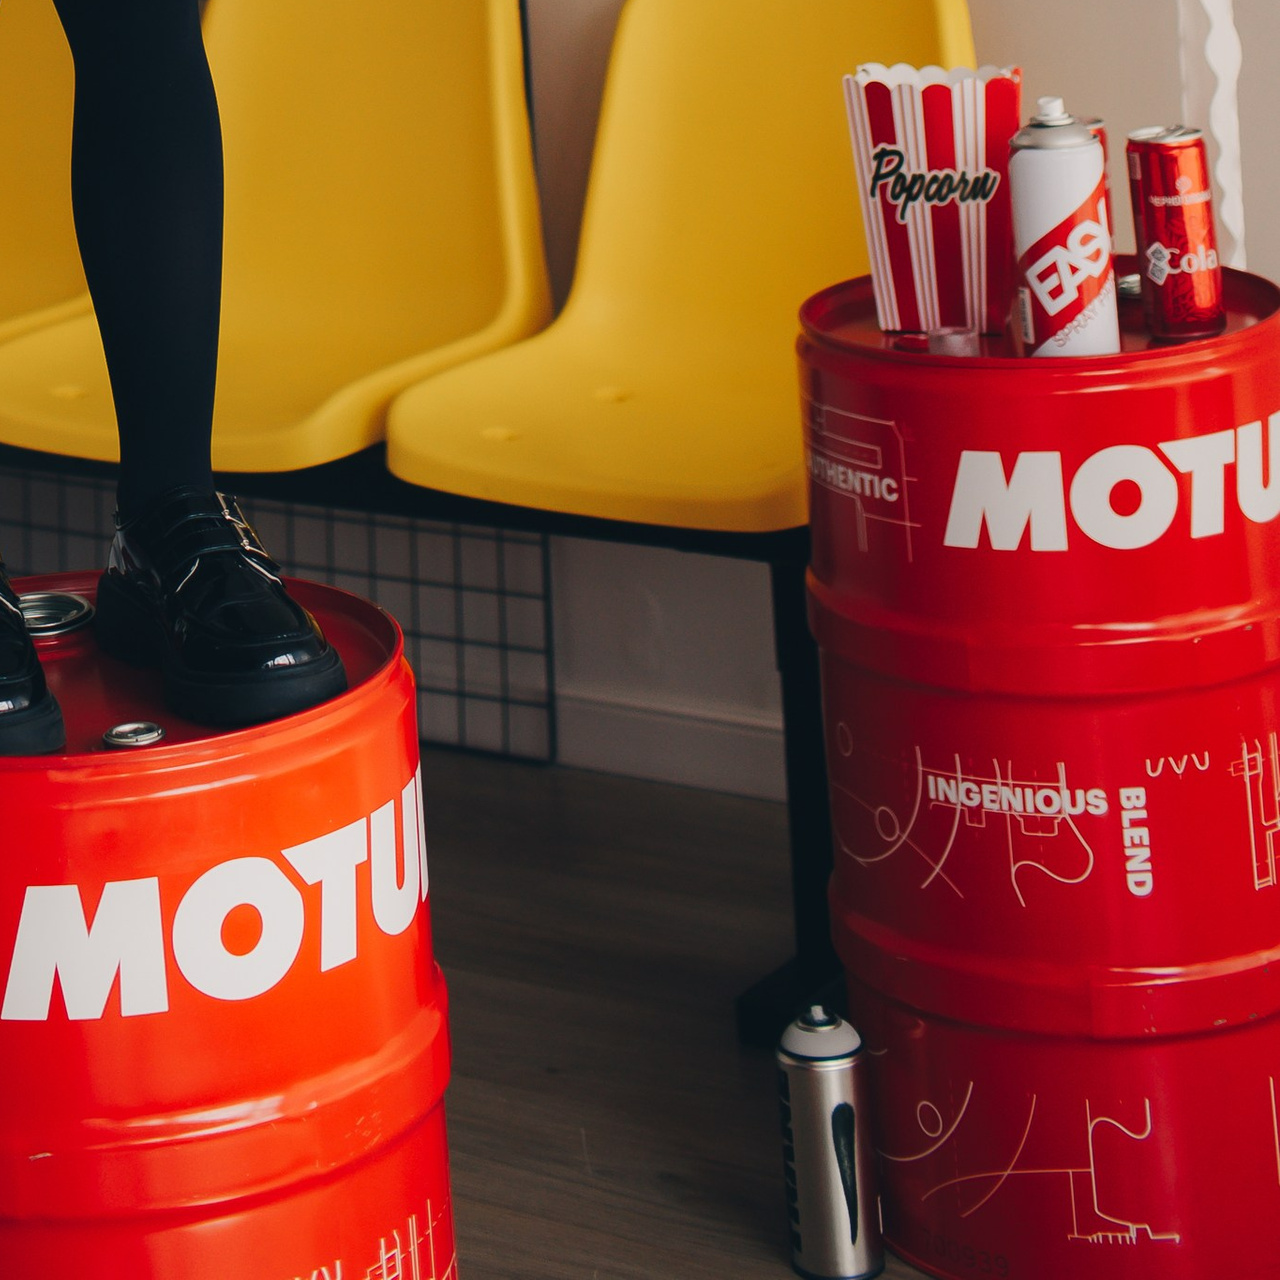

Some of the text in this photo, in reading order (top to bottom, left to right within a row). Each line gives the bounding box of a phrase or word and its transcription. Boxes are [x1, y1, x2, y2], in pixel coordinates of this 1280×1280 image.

[870, 147, 998, 221] Popcorn
[1166, 244, 1219, 274] Cola
[943, 410, 1280, 552] MOTU
[927, 775, 1109, 816] INGENIOUS
[1120, 787, 1153, 897] BLEND
